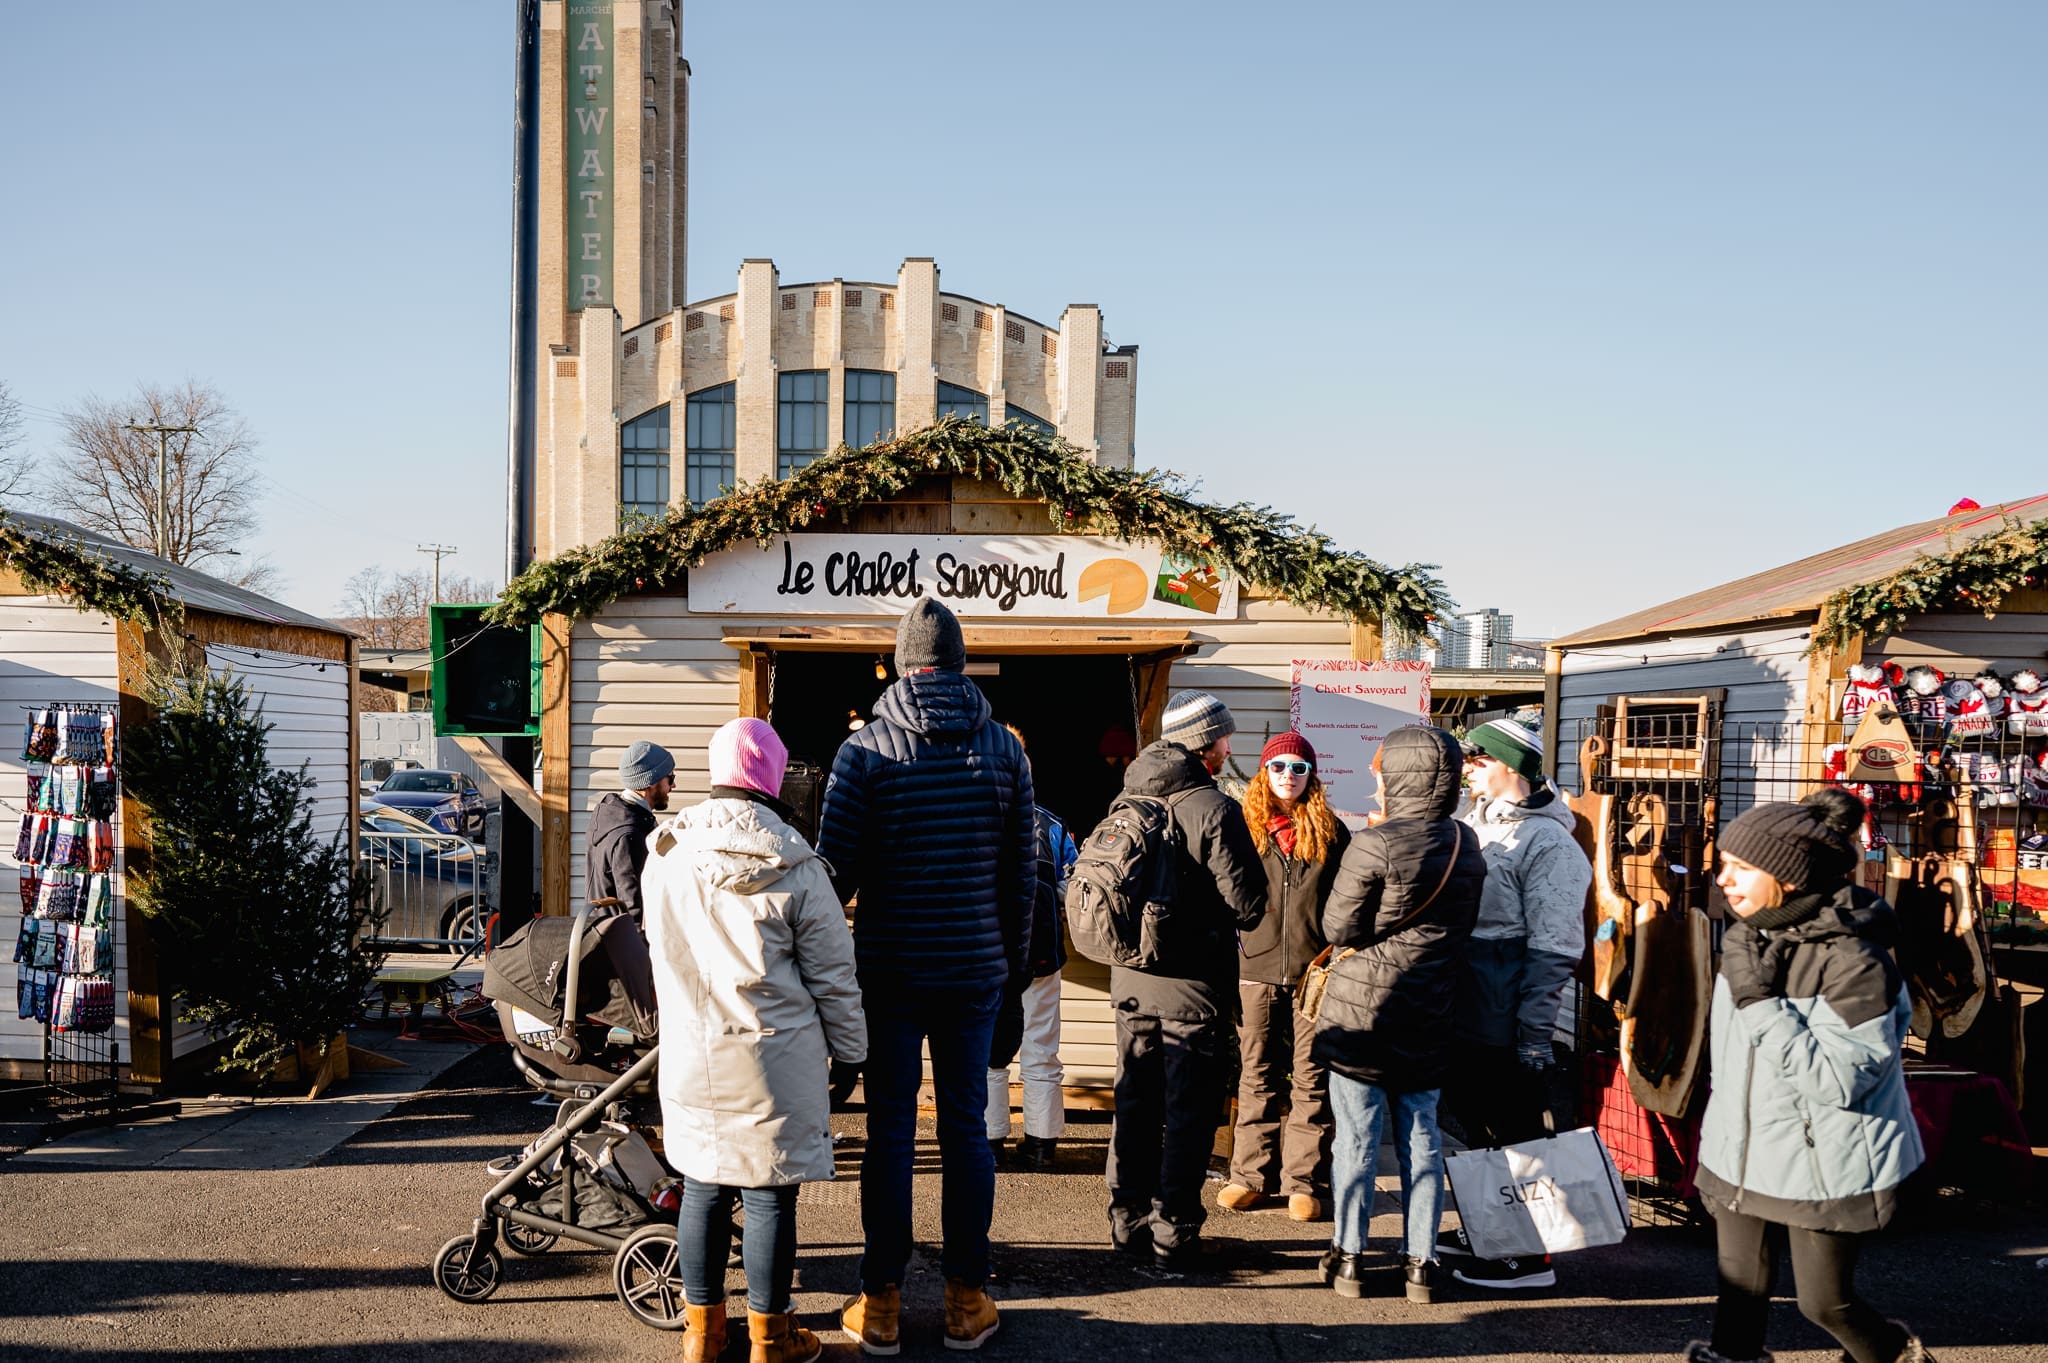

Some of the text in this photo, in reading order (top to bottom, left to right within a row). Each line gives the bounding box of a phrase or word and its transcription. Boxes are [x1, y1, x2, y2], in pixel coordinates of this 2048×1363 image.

[575, 22, 609, 302] ATWATER
[777, 540, 1068, 611] Le Chalet Savoyard
[1315, 684, 1407, 696] Chalet Savoyard
[1499, 1177, 1555, 1206] SUZY
